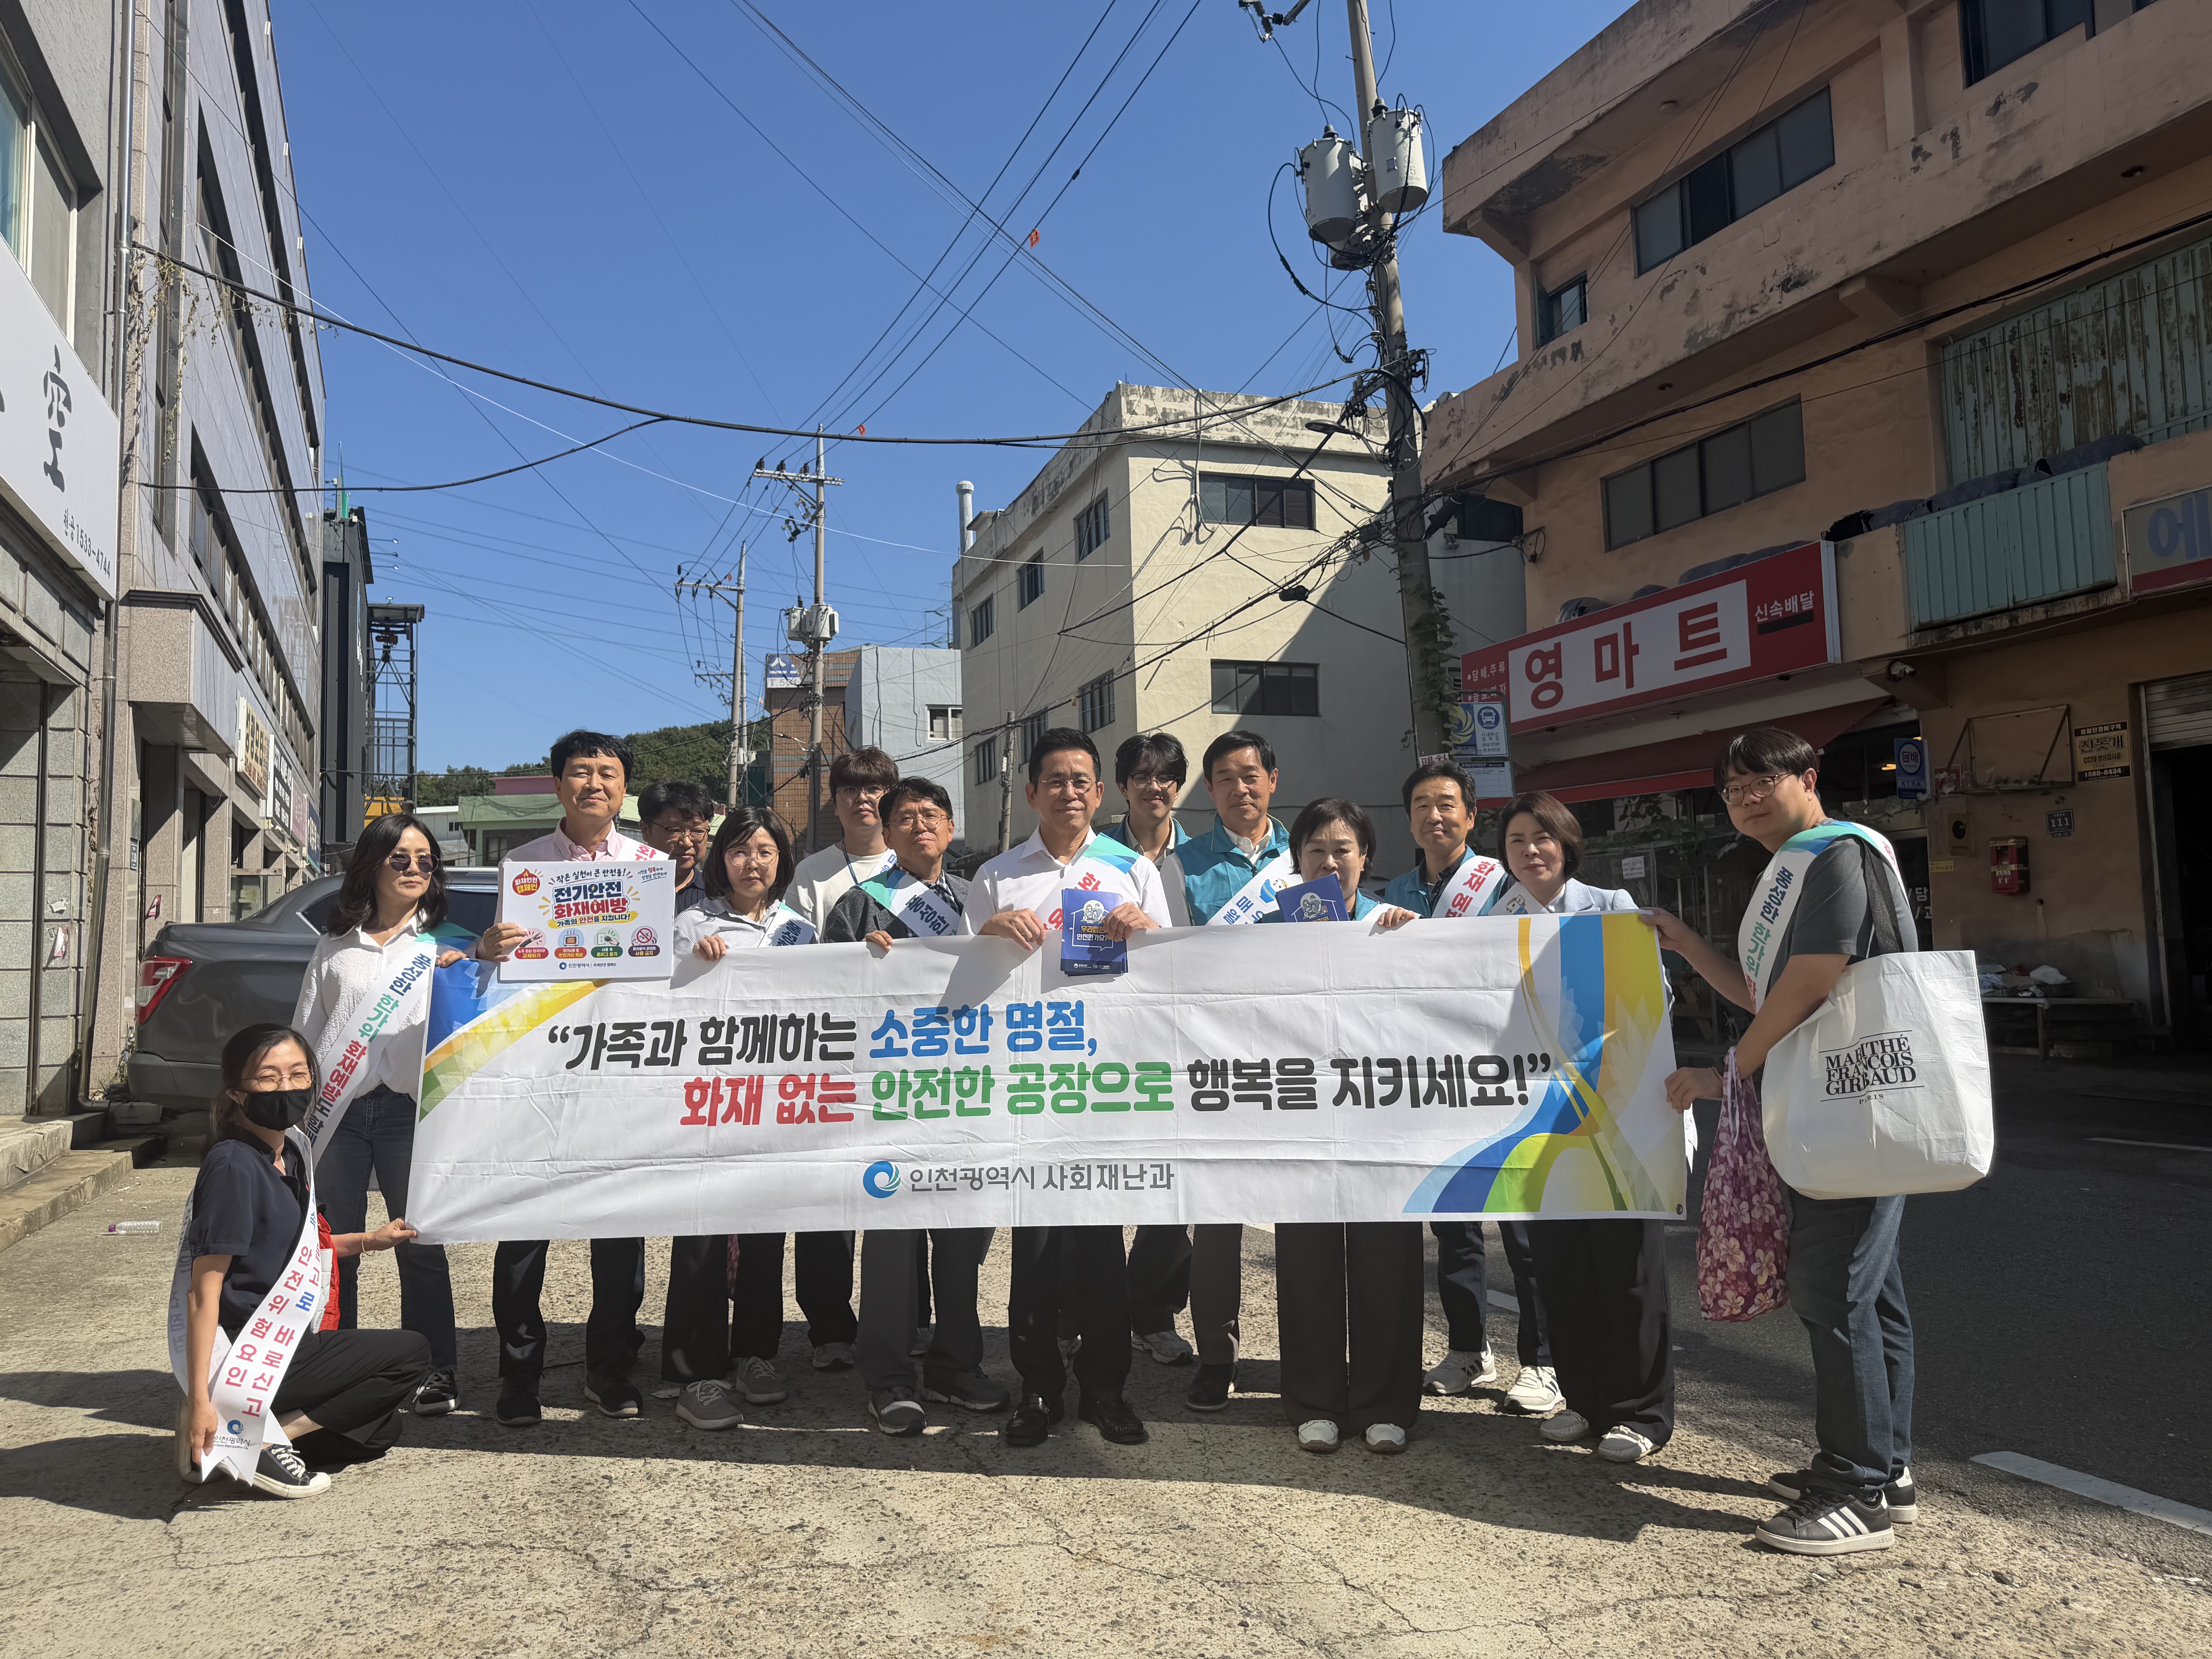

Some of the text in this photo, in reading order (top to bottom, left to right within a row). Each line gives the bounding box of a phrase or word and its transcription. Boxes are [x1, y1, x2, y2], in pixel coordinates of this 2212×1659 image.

[1754, 591, 1814, 623] 신속배달
[1525, 602, 1727, 709] 영마트
[1902, 751, 1918, 763] 담배
[2080, 734, 2124, 754] 진돗개
[2051, 817, 2070, 827] 111
[556, 868, 626, 883] 작은 실천이 큰 안전을!
[554, 881, 622, 903] 전기안전
[1760, 866, 1794, 925] 풍성한
[554, 898, 628, 920] 화재예방
[557, 918, 577, 927] 가족의
[579, 916, 599, 924] 안전을
[905, 895, 950, 935] 풍성한
[1746, 921, 1771, 978] 한가위
[389, 953, 432, 997] 풍성한
[358, 993, 400, 1043] 한가위
[548, 1001, 1096, 1070] “가족과 함께하는 소중한 명절,
[1825, 1034, 1911, 1069] MARITHÉ
[1826, 1051, 1913, 1082] FRANÇOIS
[680, 1053, 1551, 1127] 화재 없는 안전한 공장으로 행복을 지키세요!”
[1826, 1066, 1916, 1095] GIRBAUD
[910, 1163, 1175, 1192] 인천광역시 사회재난과
[242, 1325, 295, 1418] 바로신고
[214, 1435, 251, 1446] 인천광역시
